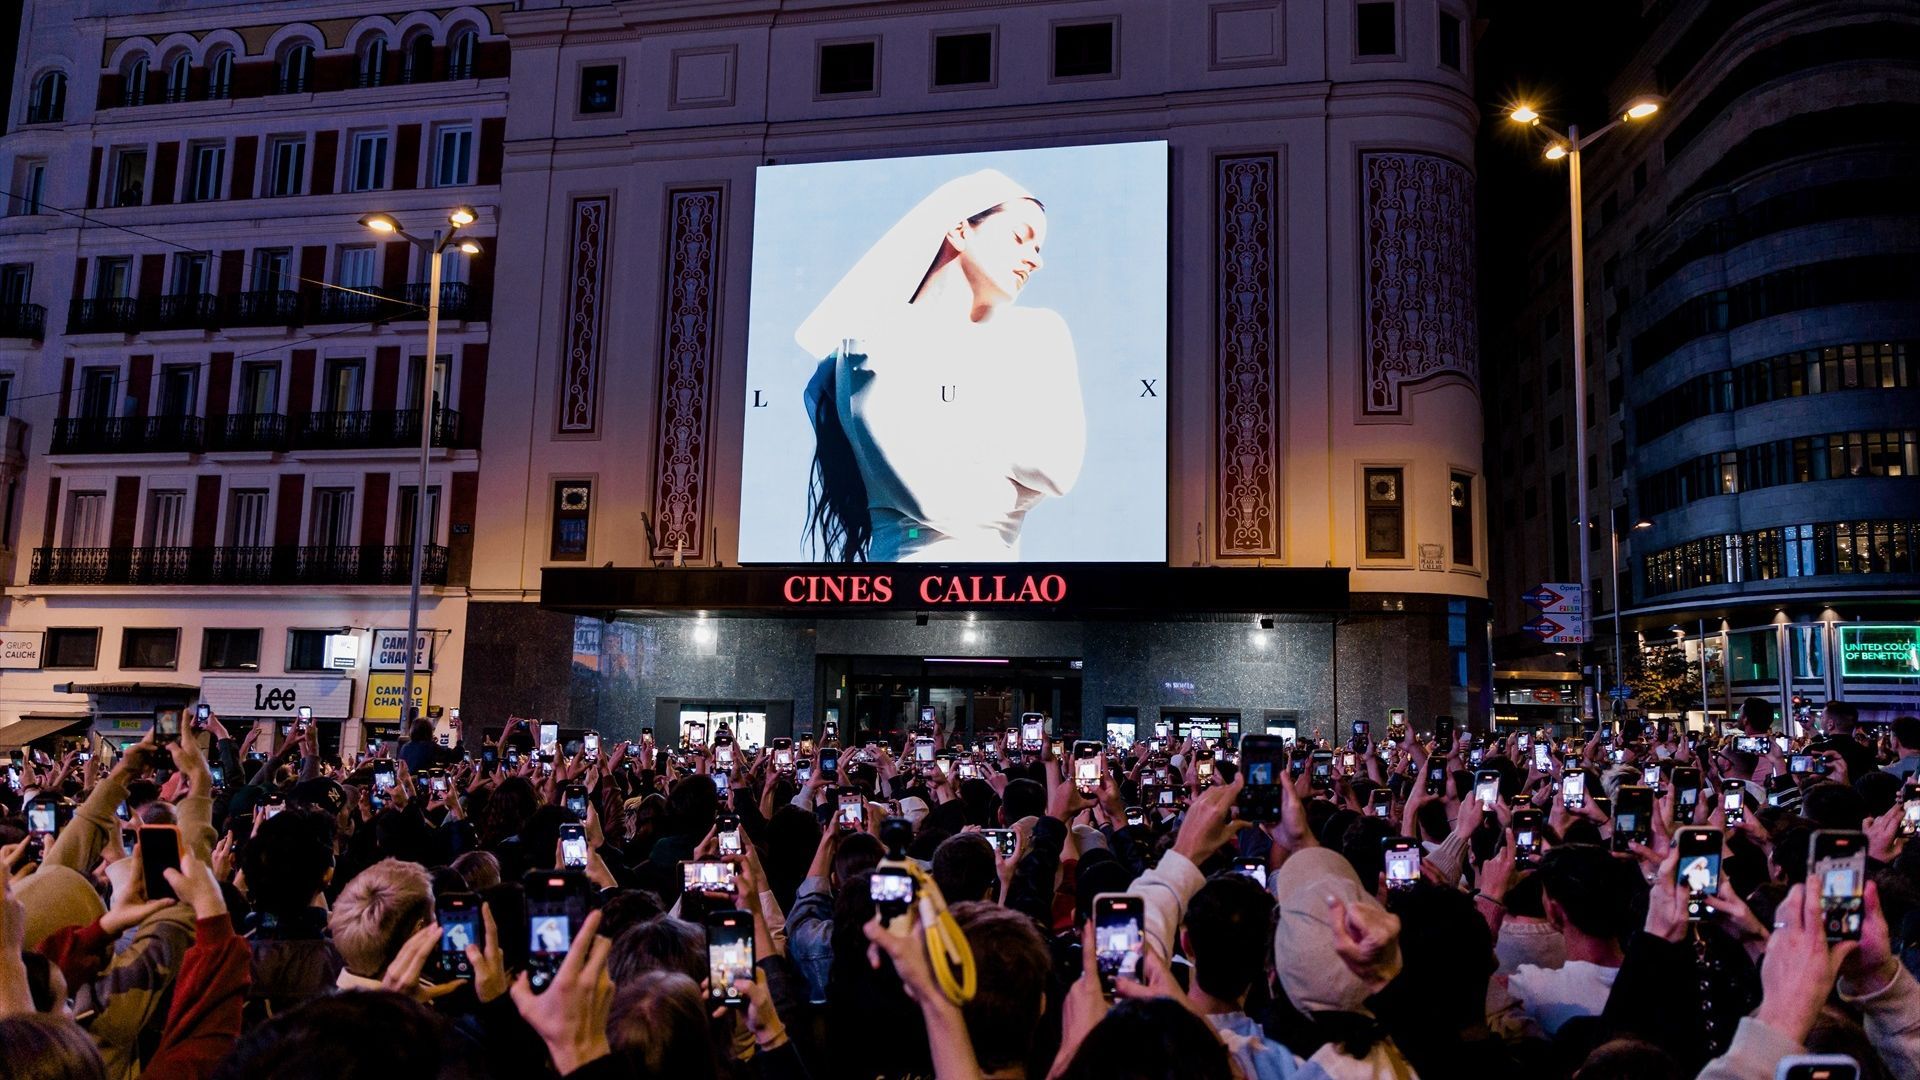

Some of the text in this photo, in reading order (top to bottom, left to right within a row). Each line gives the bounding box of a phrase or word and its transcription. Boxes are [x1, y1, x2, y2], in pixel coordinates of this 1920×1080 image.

[753, 379, 1157, 408] L U X
[784, 575, 1066, 603] CINES CALLAO
[1845, 643, 1880, 651] UNITED
[1846, 652, 1913, 660] OF BENETTON
[254, 684, 296, 711] Lee
